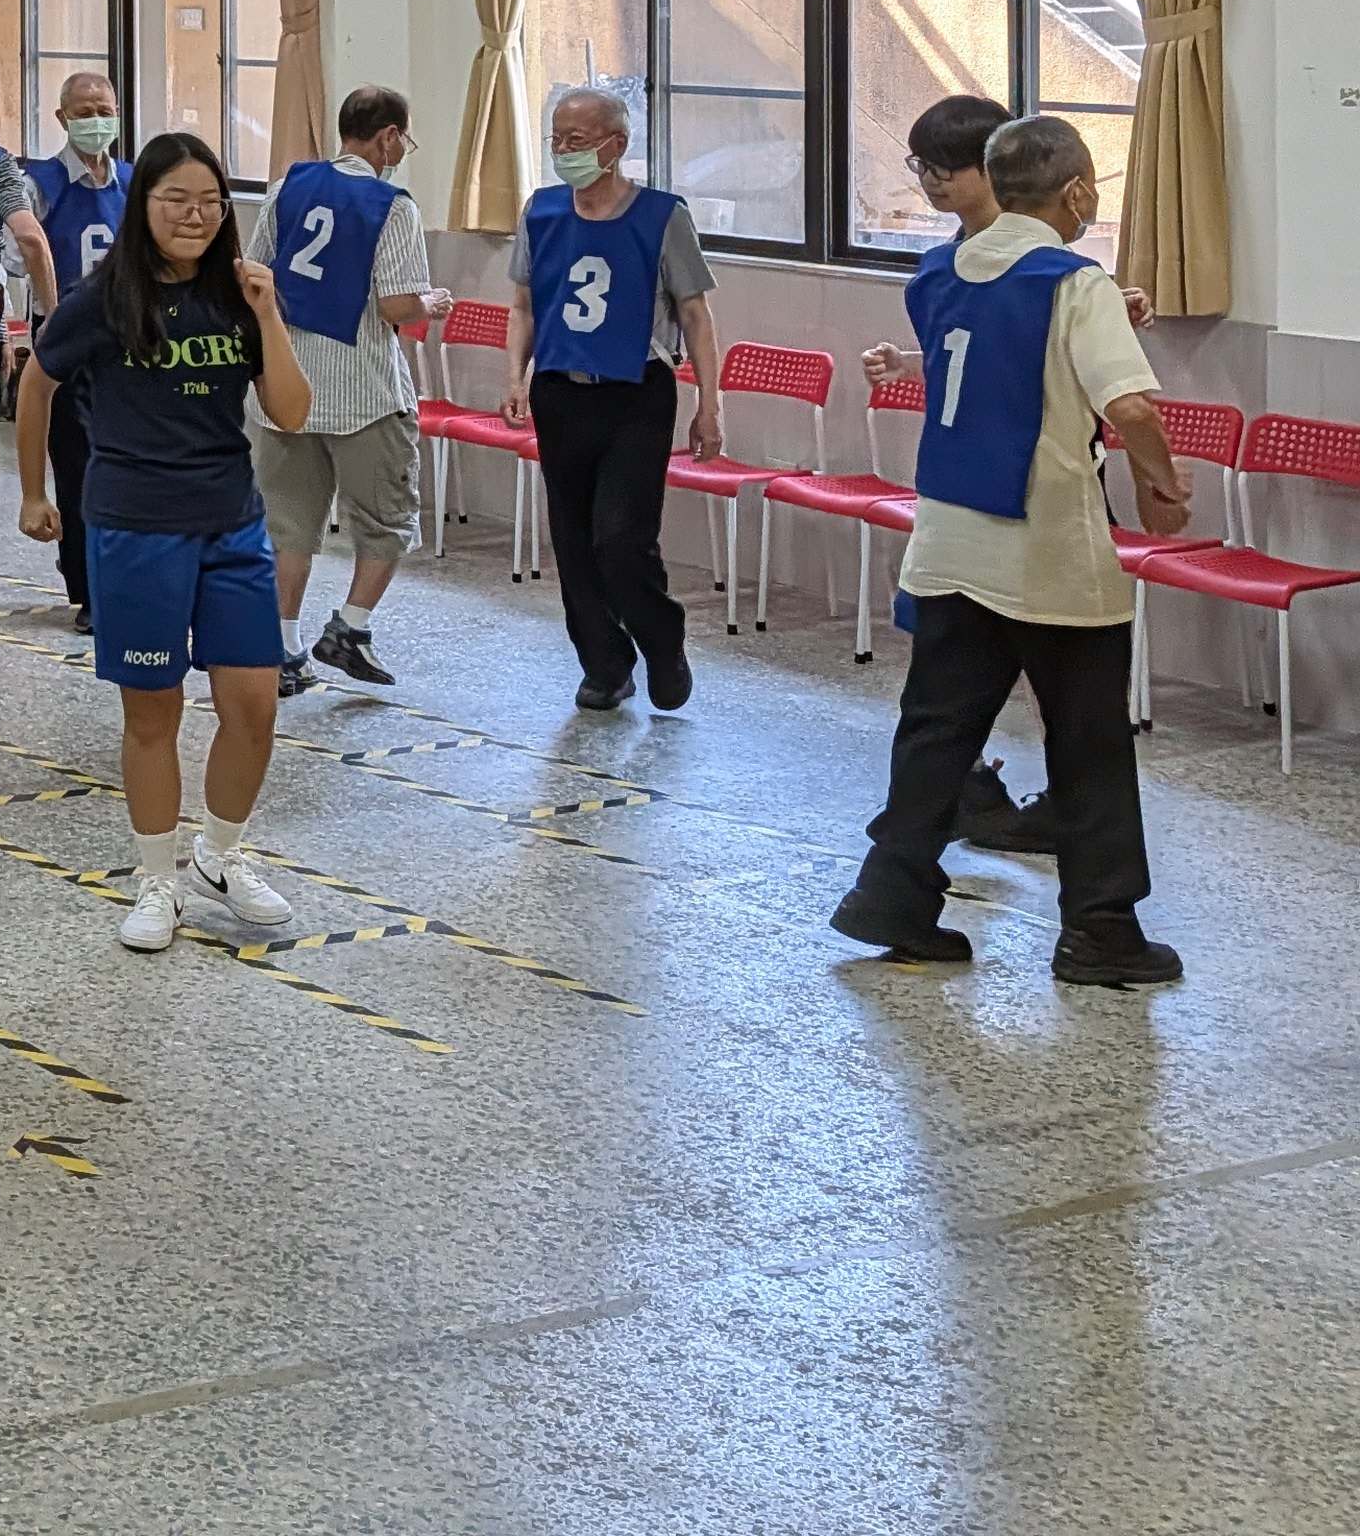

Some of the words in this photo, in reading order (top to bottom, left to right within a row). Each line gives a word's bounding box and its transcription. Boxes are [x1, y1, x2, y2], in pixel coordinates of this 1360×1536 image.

[81, 224, 115, 279] 6
[288, 206, 335, 281] 2
[562, 255, 612, 333] 3
[182, 381, 210, 395] 17th
[940, 327, 971, 427] 1
[123, 650, 170, 666] NOCSH
